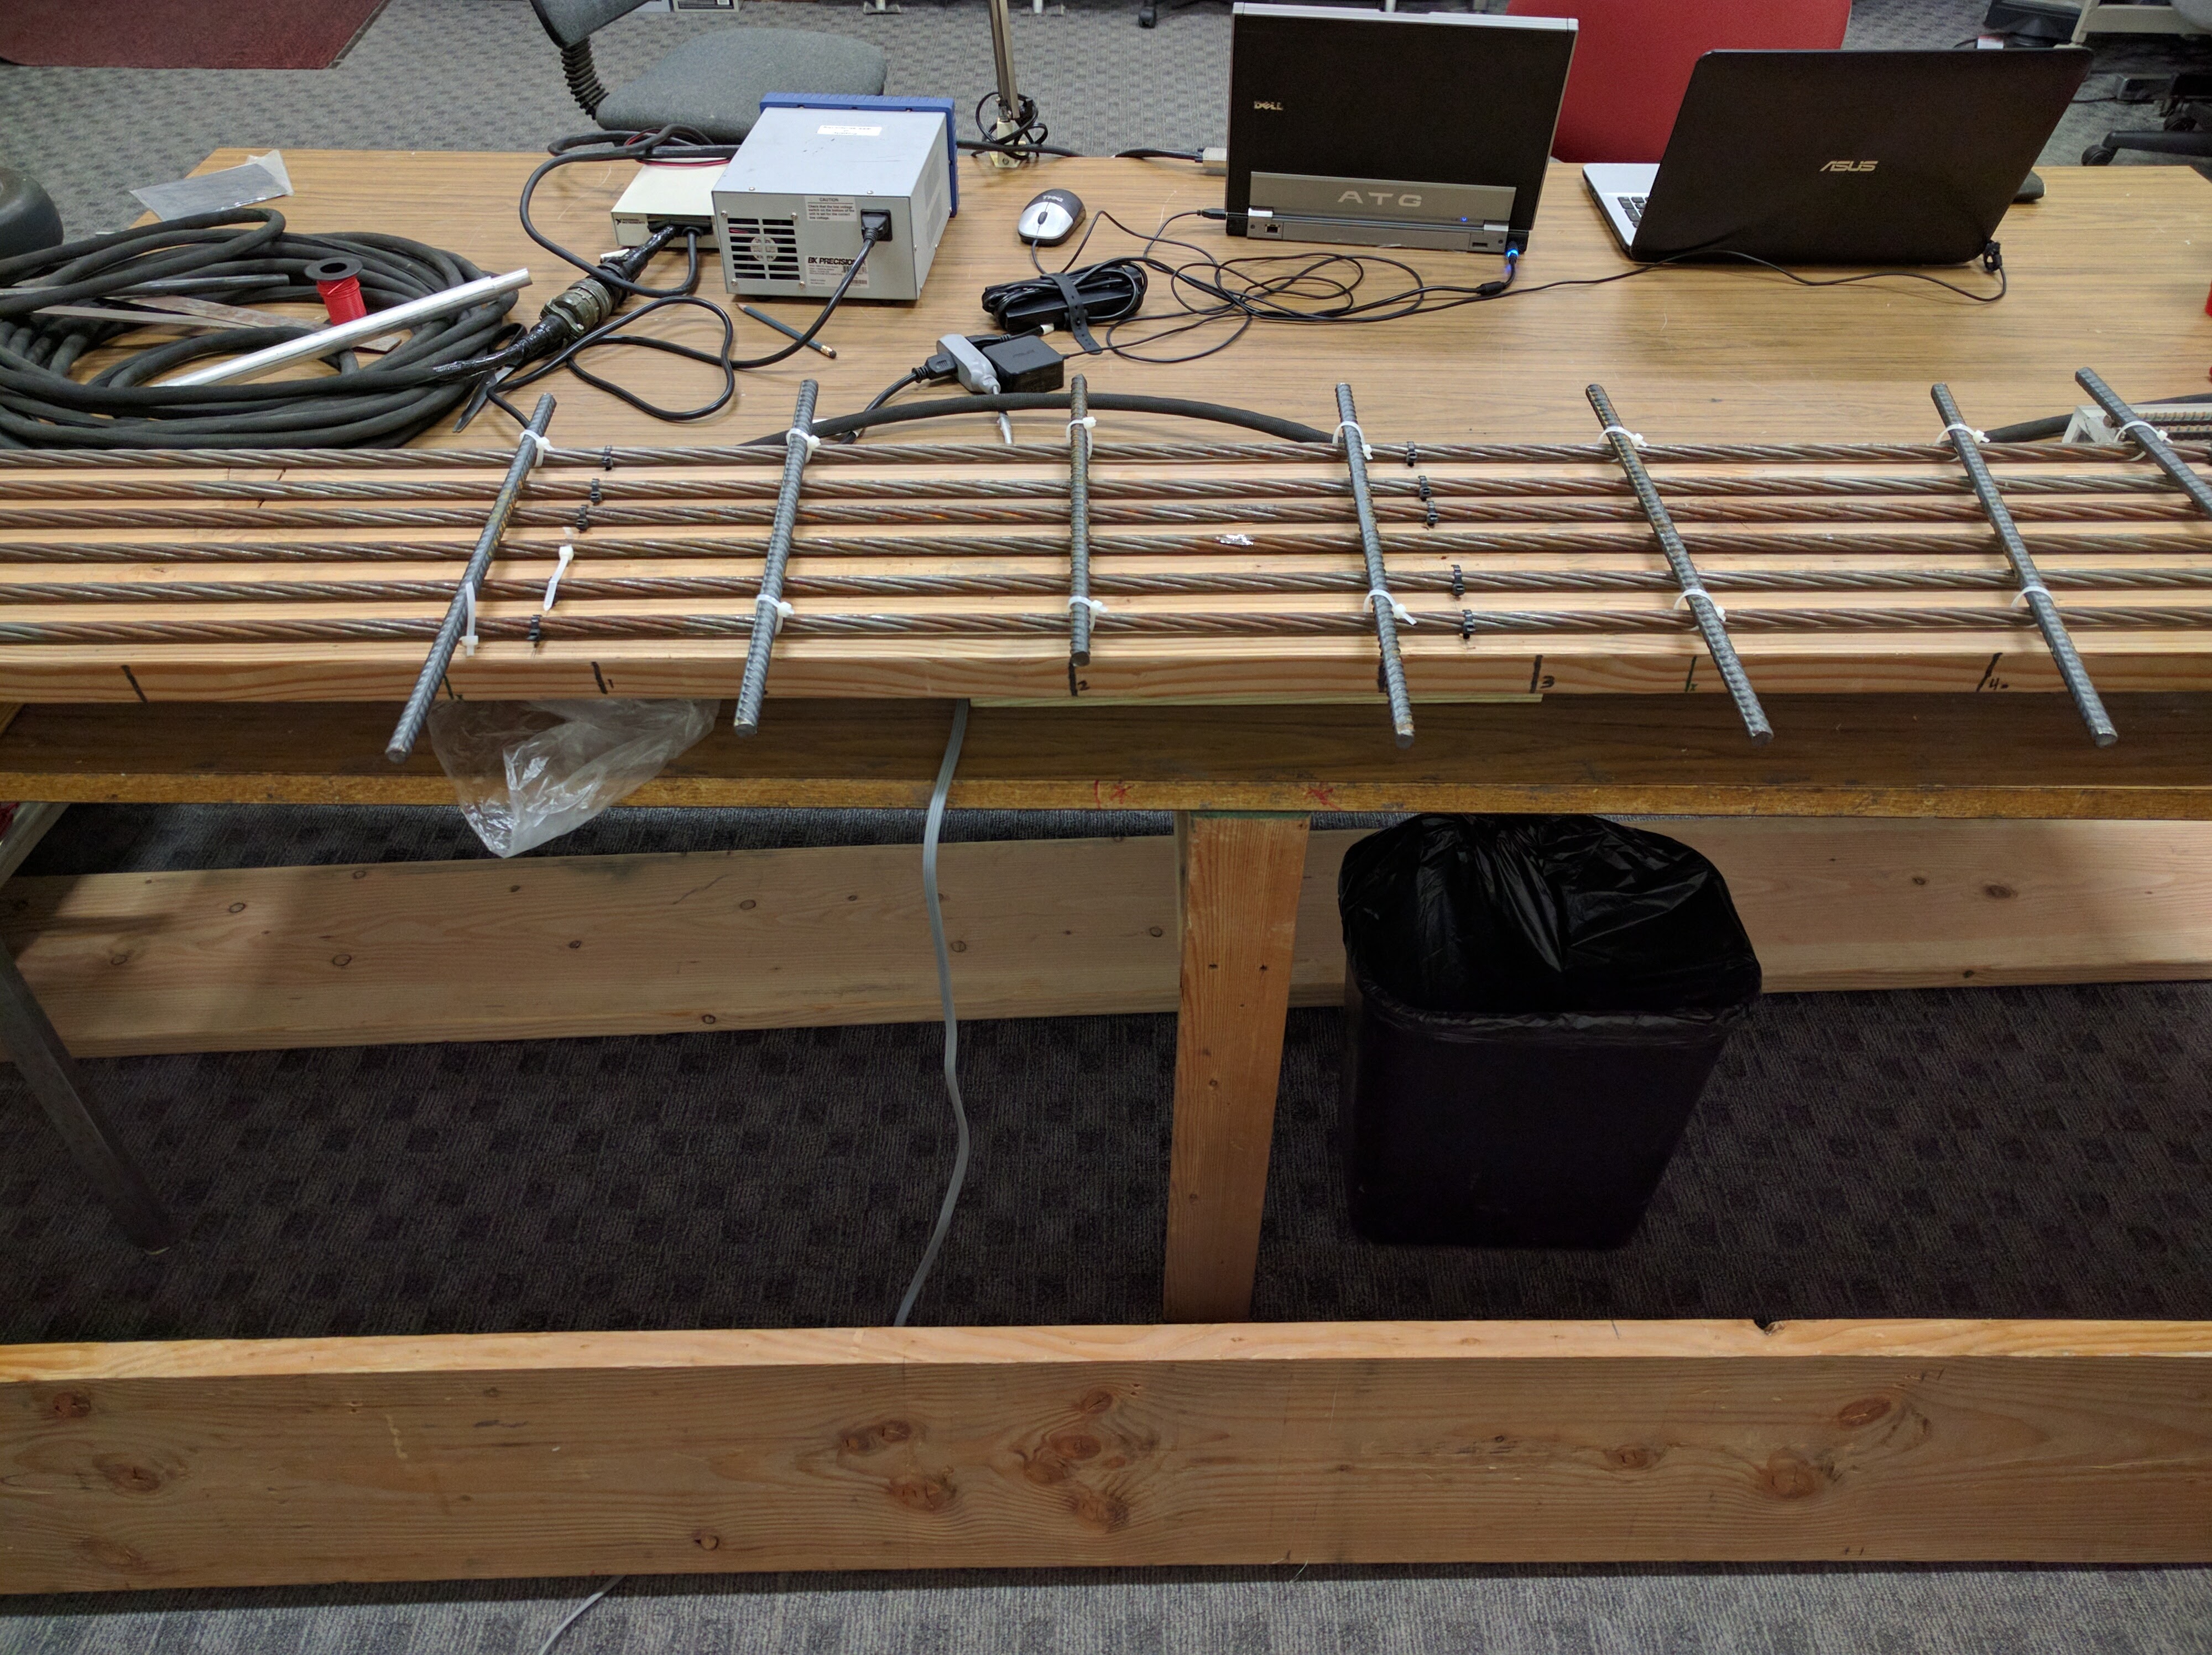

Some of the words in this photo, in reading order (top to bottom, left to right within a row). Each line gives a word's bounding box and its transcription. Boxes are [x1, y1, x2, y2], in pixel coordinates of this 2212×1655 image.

[1254, 101, 1283, 111] DELL
[1819, 160, 1879, 171] ASUS
[1337, 190, 1422, 207] ATG
[1540, 675, 1555, 689] 3
